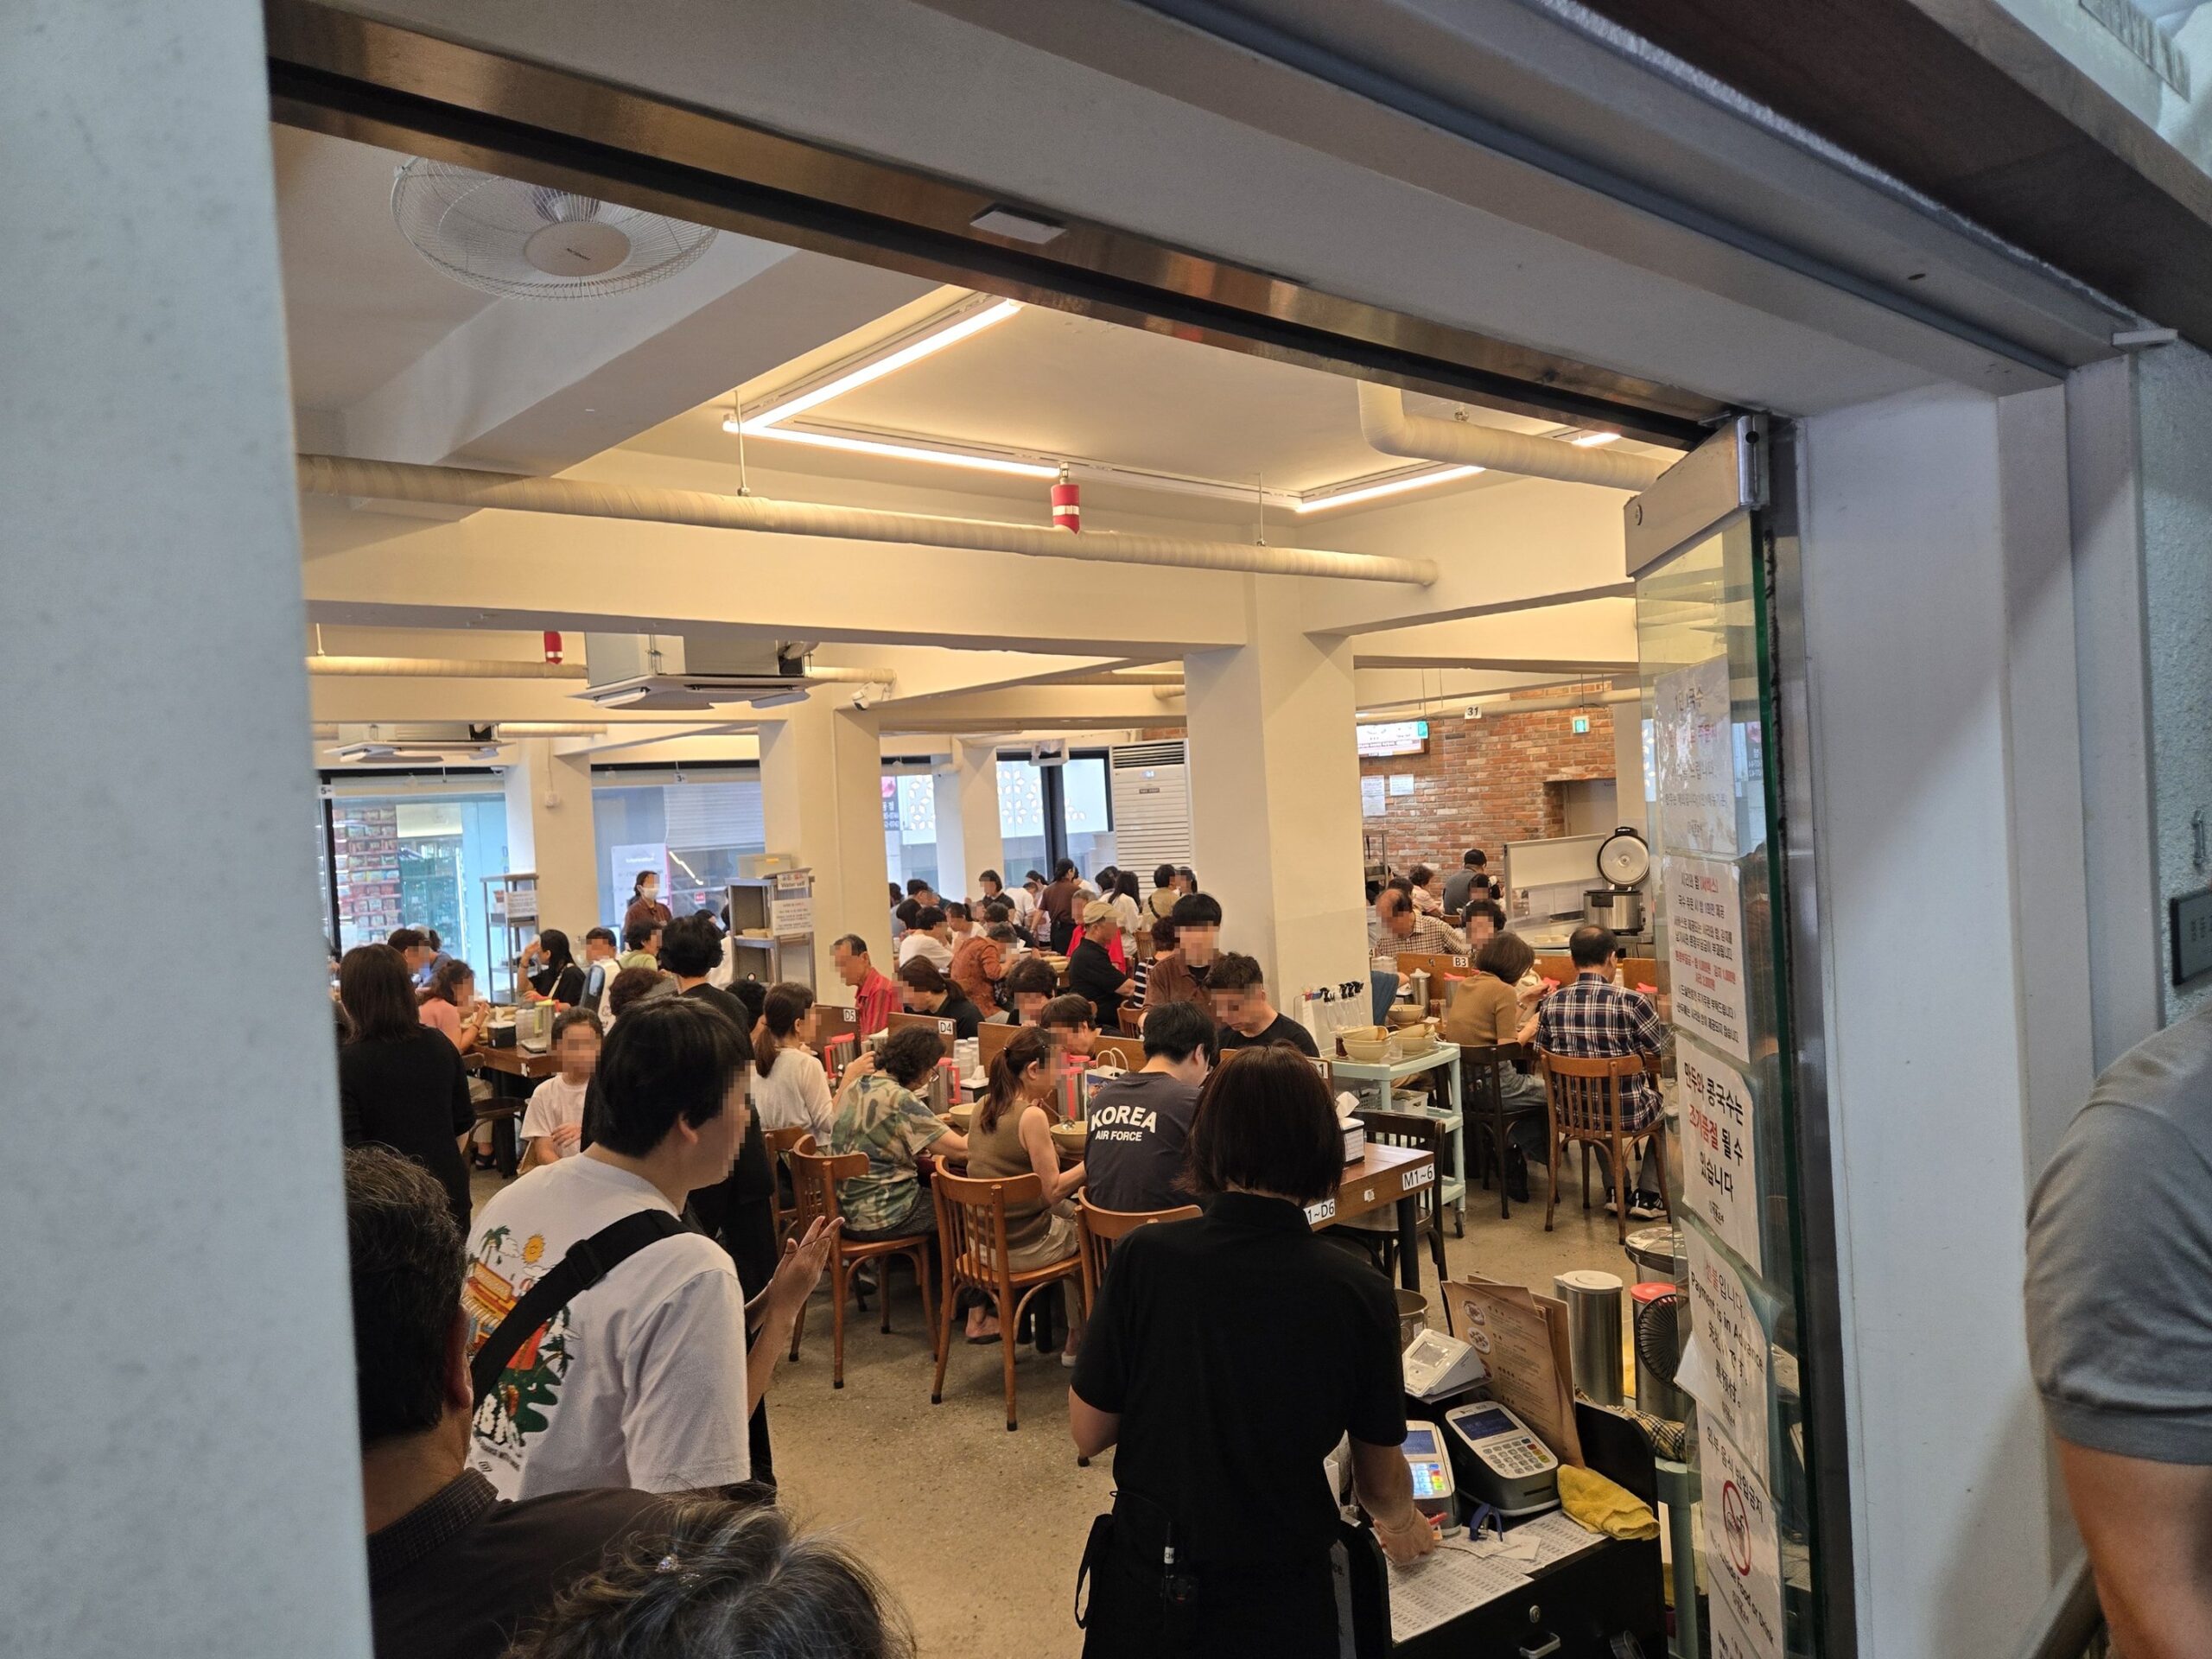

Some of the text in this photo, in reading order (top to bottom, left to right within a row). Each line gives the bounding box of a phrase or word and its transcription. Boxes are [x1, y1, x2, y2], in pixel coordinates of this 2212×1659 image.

[1467, 706, 1479, 716] 31
[1455, 957, 1466, 967] B3
[844, 1010, 855, 1020] D5
[940, 1021, 952, 1033] D4
[1684, 1062, 1744, 1127] 만두와 콩국수는
[1090, 1105, 1158, 1134] KOREA
[1095, 1129, 1143, 1141] AIR FORCE
[1689, 1103, 1744, 1167] 조기품절 될 수
[1403, 1165, 1433, 1189] M1~6
[1700, 1151, 1733, 1204] 있습니다
[1306, 1201, 1335, 1223] 1~D6
[1706, 1260, 1745, 1320] 선불입니다.
[1691, 1271, 1764, 1375] Payment is in Advance
[1707, 1426, 1764, 1523] 외부 음식 반입금지
